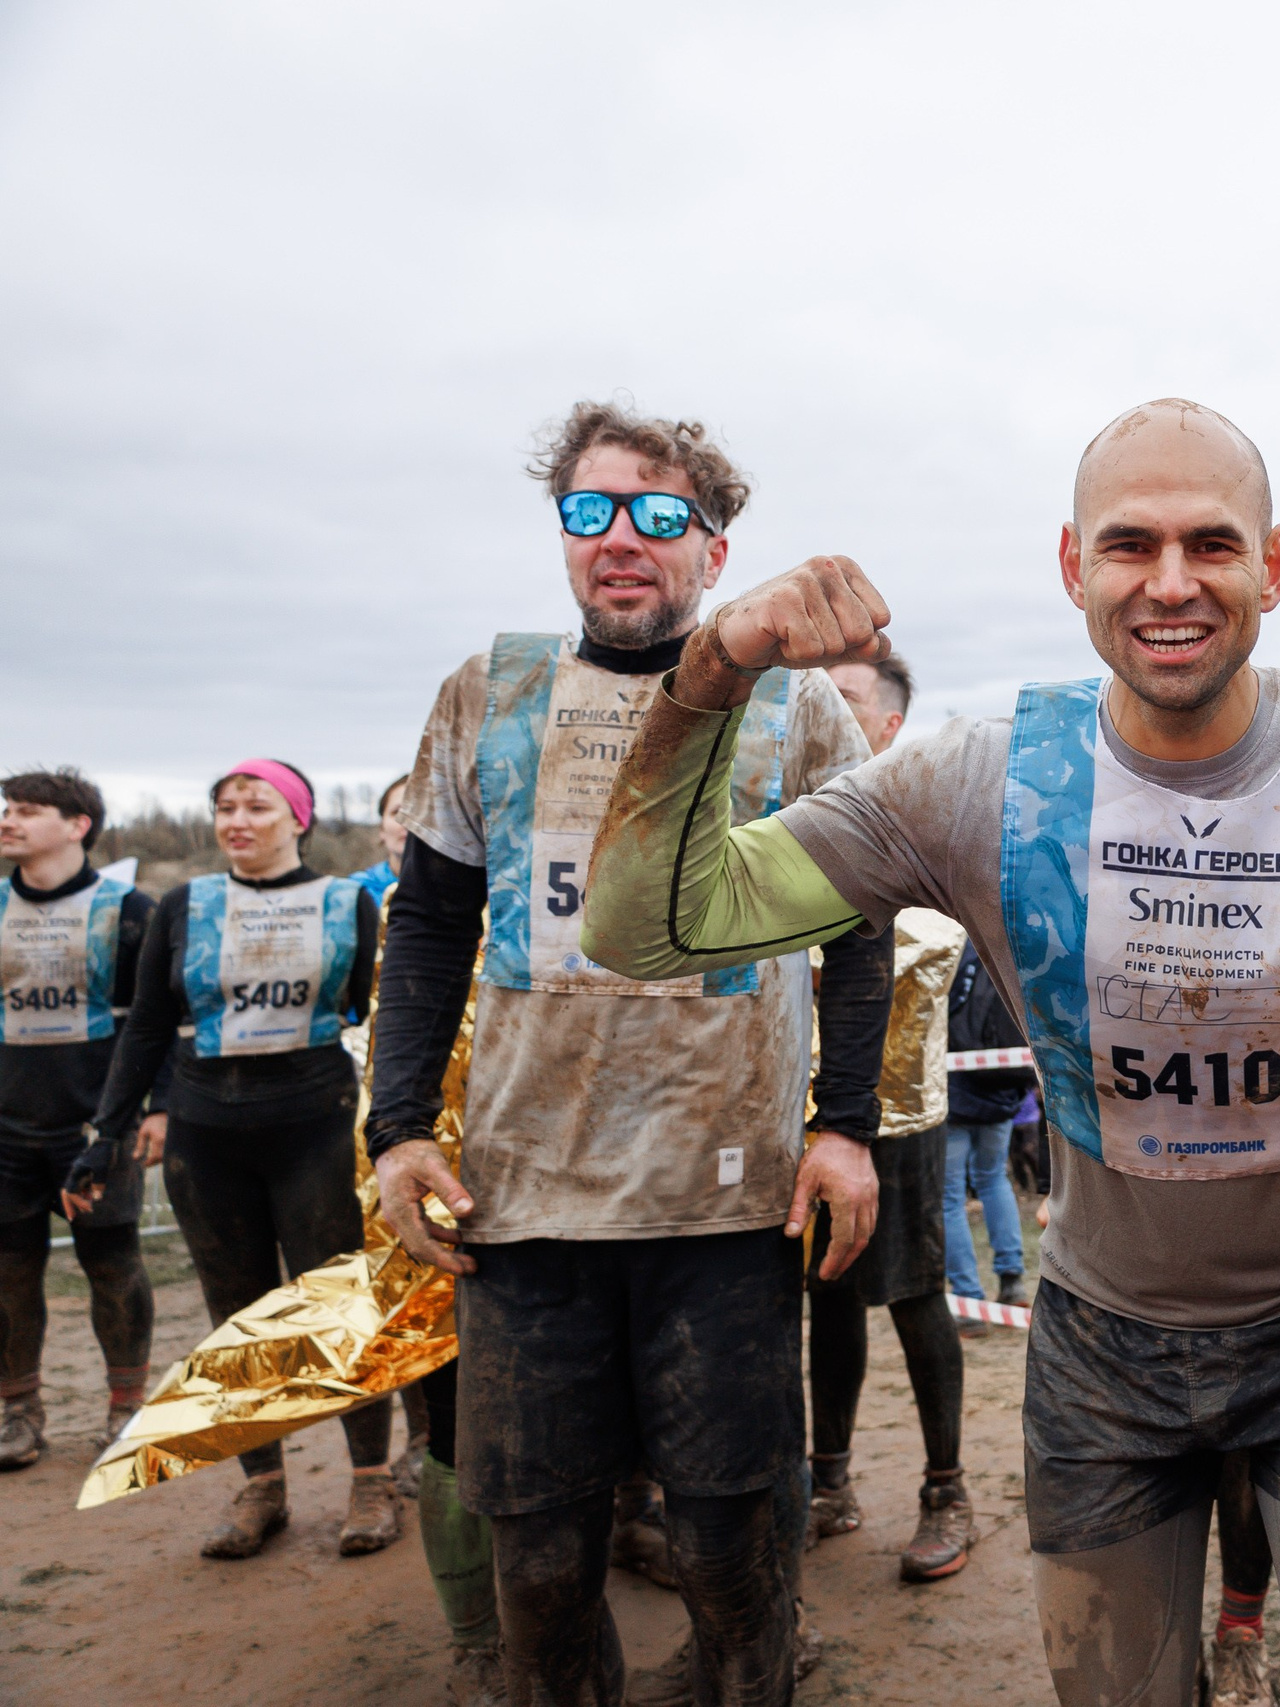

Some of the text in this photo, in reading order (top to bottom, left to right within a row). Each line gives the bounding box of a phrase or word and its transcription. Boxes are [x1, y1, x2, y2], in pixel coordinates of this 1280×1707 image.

[557, 708, 621, 724] ГОНКА
[571, 735, 628, 762] Smi
[1102, 841, 1188, 870] ГОНКА
[1128, 886, 1264, 930] Sminex
[1126, 941, 1264, 961] ПЕРФЕКЦИОНИСТЫ
[1124, 960, 1264, 980] FINE DEVELOPMENT
[9, 985, 78, 1012] 5404
[232, 979, 310, 1013] 5403
[1167, 1139, 1267, 1155] ГАЗПРОМБАНК
